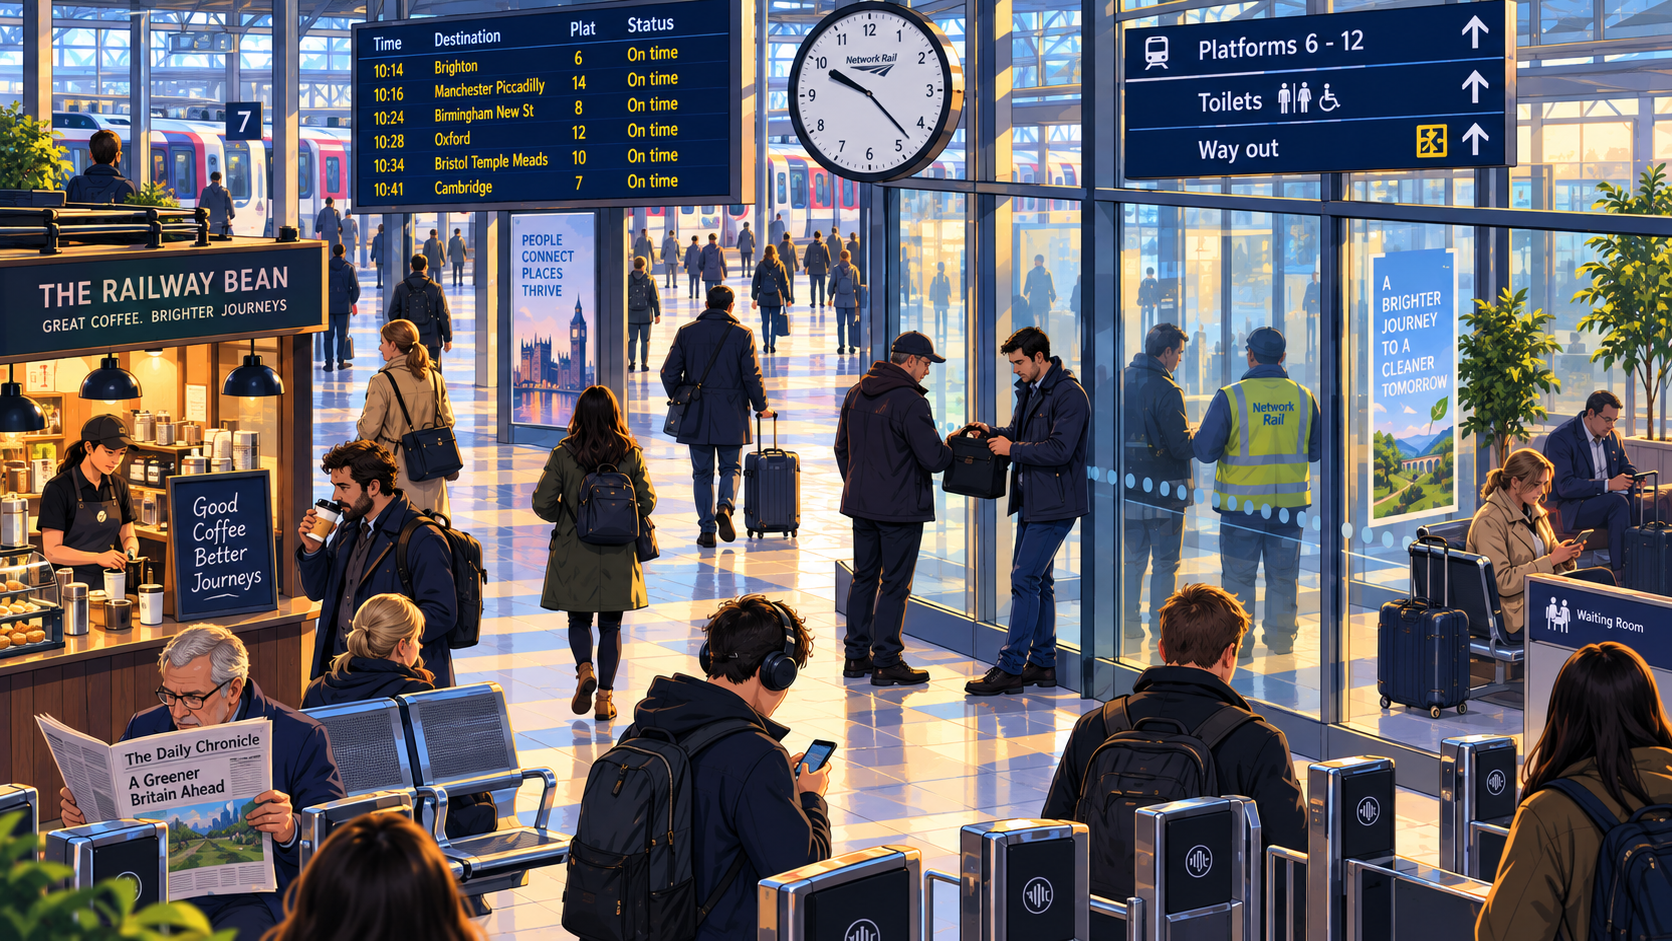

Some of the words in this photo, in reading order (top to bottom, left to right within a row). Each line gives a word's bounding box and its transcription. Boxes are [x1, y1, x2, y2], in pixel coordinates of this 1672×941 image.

[373, 37, 402, 51] Time
[435, 29, 500, 47] Destination
[571, 20, 596, 37] Plat
[628, 17, 674, 32] Status
[837, 34, 847, 45] 11
[863, 24, 876, 36] 12
[897, 30, 901, 42] 1
[1199, 37, 1297, 60] Platforms
[1305, 33, 1318, 53] 6
[1341, 29, 1363, 51] 12
[374, 63, 403, 78] 10:14
[435, 60, 477, 76] Brighton
[574, 51, 582, 65] 6
[628, 47, 645, 61] On
[650, 46, 678, 60] time
[815, 57, 827, 69] 10
[846, 55, 880, 64] Network
[882, 53, 897, 62] Rail
[918, 52, 925, 64] 2
[374, 87, 403, 101] 10:16
[435, 83, 493, 98] Manchester
[497, 78, 545, 95] Piccadilly
[572, 75, 586, 90] 14
[628, 72, 645, 87] On
[650, 71, 678, 85] time
[809, 89, 815, 101] 9
[926, 84, 933, 97] 3
[374, 111, 404, 125] 10:24
[435, 107, 493, 123] Birmingham
[497, 105, 519, 118] New
[523, 104, 534, 117] St
[575, 100, 582, 115] 8
[628, 98, 645, 112] On
[650, 96, 678, 111] time
[1198, 91, 1262, 112] Toilets
[238, 111, 251, 132] 7
[817, 119, 824, 131] 8
[917, 116, 925, 129] 4
[374, 134, 404, 149] 10:28
[435, 131, 470, 146] Oxford
[572, 125, 586, 139] 12
[628, 123, 645, 137] On
[650, 122, 678, 136] time
[839, 140, 845, 152] 7
[895, 140, 902, 151] 5
[374, 158, 404, 172] 10:34
[435, 156, 468, 170] Bristol
[471, 154, 509, 171] Temple
[513, 152, 548, 167] Meads
[572, 150, 586, 165] 10
[628, 148, 645, 163] On
[650, 148, 678, 162] time
[866, 147, 873, 160] 6
[1198, 140, 1239, 163] Way
[1246, 139, 1279, 158] out
[374, 182, 403, 196] 10:41
[435, 179, 492, 197] Cambridge
[575, 176, 583, 190] 7
[628, 174, 645, 188] On
[650, 173, 678, 187] time
[522, 234, 562, 246] PEOPLE
[522, 250, 574, 262] CONNECT
[522, 267, 563, 279] PLACES
[1382, 276, 1391, 291] A
[39, 281, 91, 308] THE
[103, 271, 214, 303] RAILWAY
[224, 266, 288, 293] BEAN
[522, 285, 562, 296] THRIVE
[1382, 291, 1441, 312] BRIGHTER
[43, 317, 85, 333] GREAT
[91, 312, 143, 328] COFFEE.
[151, 306, 213, 322] BRIGHTER
[221, 299, 287, 317] JOURNEYS
[1382, 312, 1438, 334] JOURNEY
[1382, 339, 1398, 356] TO
[1402, 338, 1410, 353] A
[1382, 356, 1434, 377] CLEANER
[1382, 374, 1448, 397] TOMORROW
[1253, 401, 1294, 413] Network
[1263, 413, 1284, 426] Rail
[193, 492, 238, 519] Good
[193, 519, 246, 545] Coffee
[194, 546, 247, 567] Better
[191, 571, 261, 592] Journeys
[1577, 609, 1613, 629] Waiting
[1616, 617, 1643, 633] Room
[125, 752, 151, 766] The
[157, 744, 191, 760] Daily
[196, 734, 260, 753] Chronicle
[129, 776, 139, 790] A
[144, 769, 200, 787] Greener
[130, 788, 176, 806] Britain
[181, 779, 224, 798] Ahead
